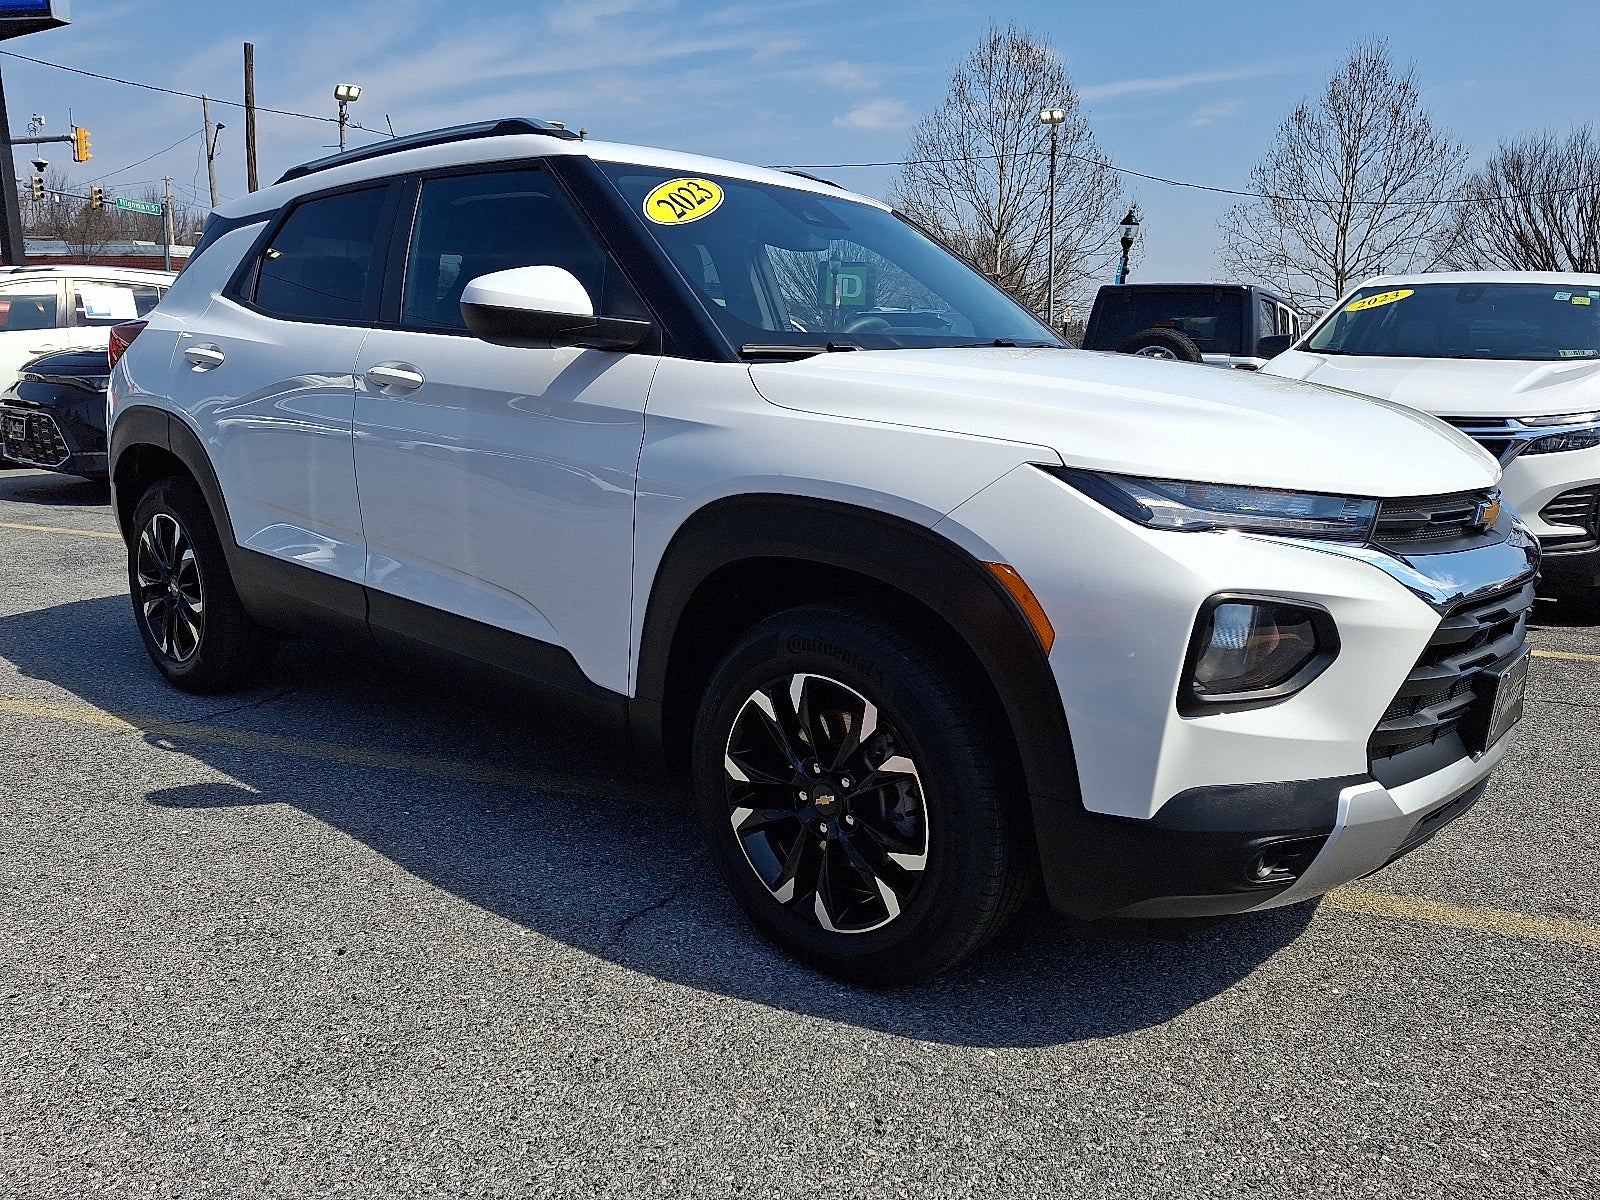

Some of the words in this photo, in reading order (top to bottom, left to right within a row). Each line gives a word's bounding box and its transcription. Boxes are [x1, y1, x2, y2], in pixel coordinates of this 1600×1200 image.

[151, 204, 159, 212] St
[656, 181, 714, 219] 2023
[1356, 291, 1400, 309] 2023
